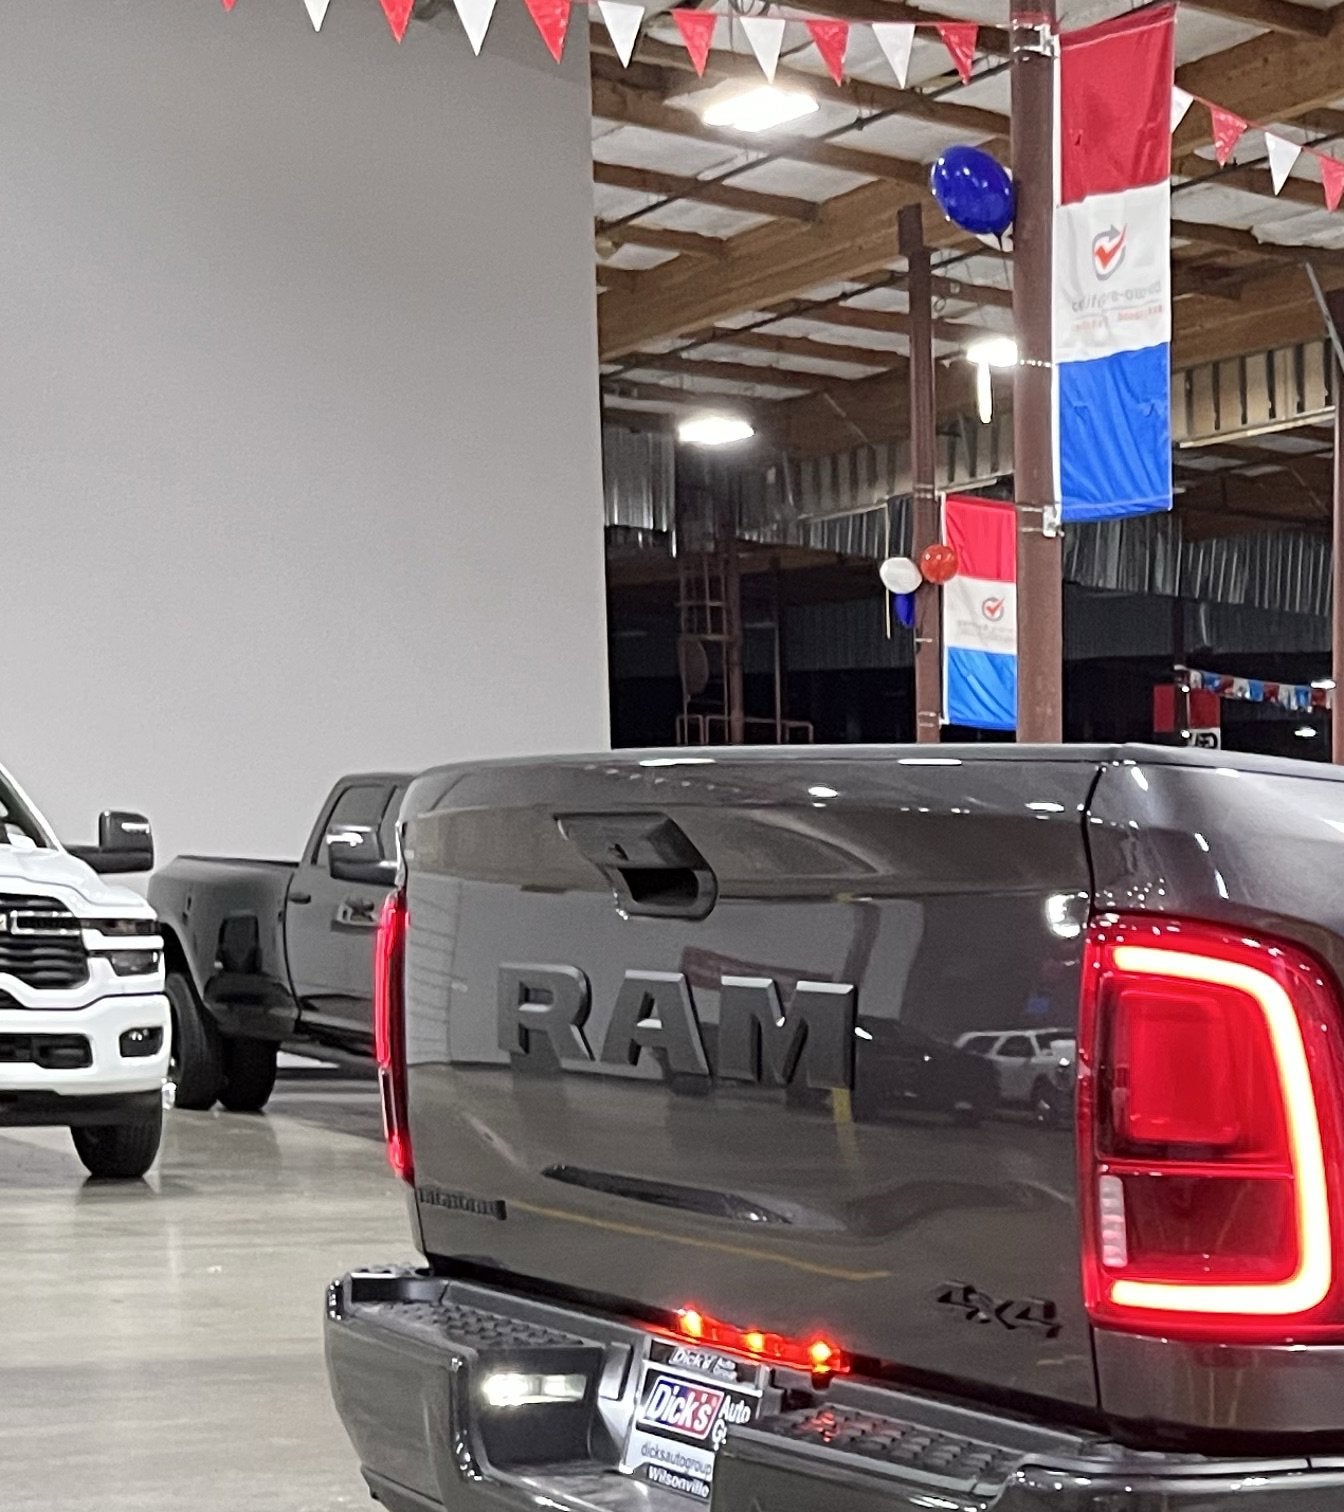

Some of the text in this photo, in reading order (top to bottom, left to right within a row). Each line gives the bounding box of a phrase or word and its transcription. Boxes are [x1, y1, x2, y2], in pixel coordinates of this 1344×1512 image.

[498, 961, 859, 1091] RAM
[646, 1383, 751, 1432] Dick's Auto
[649, 1465, 710, 1498] Wilsonville
